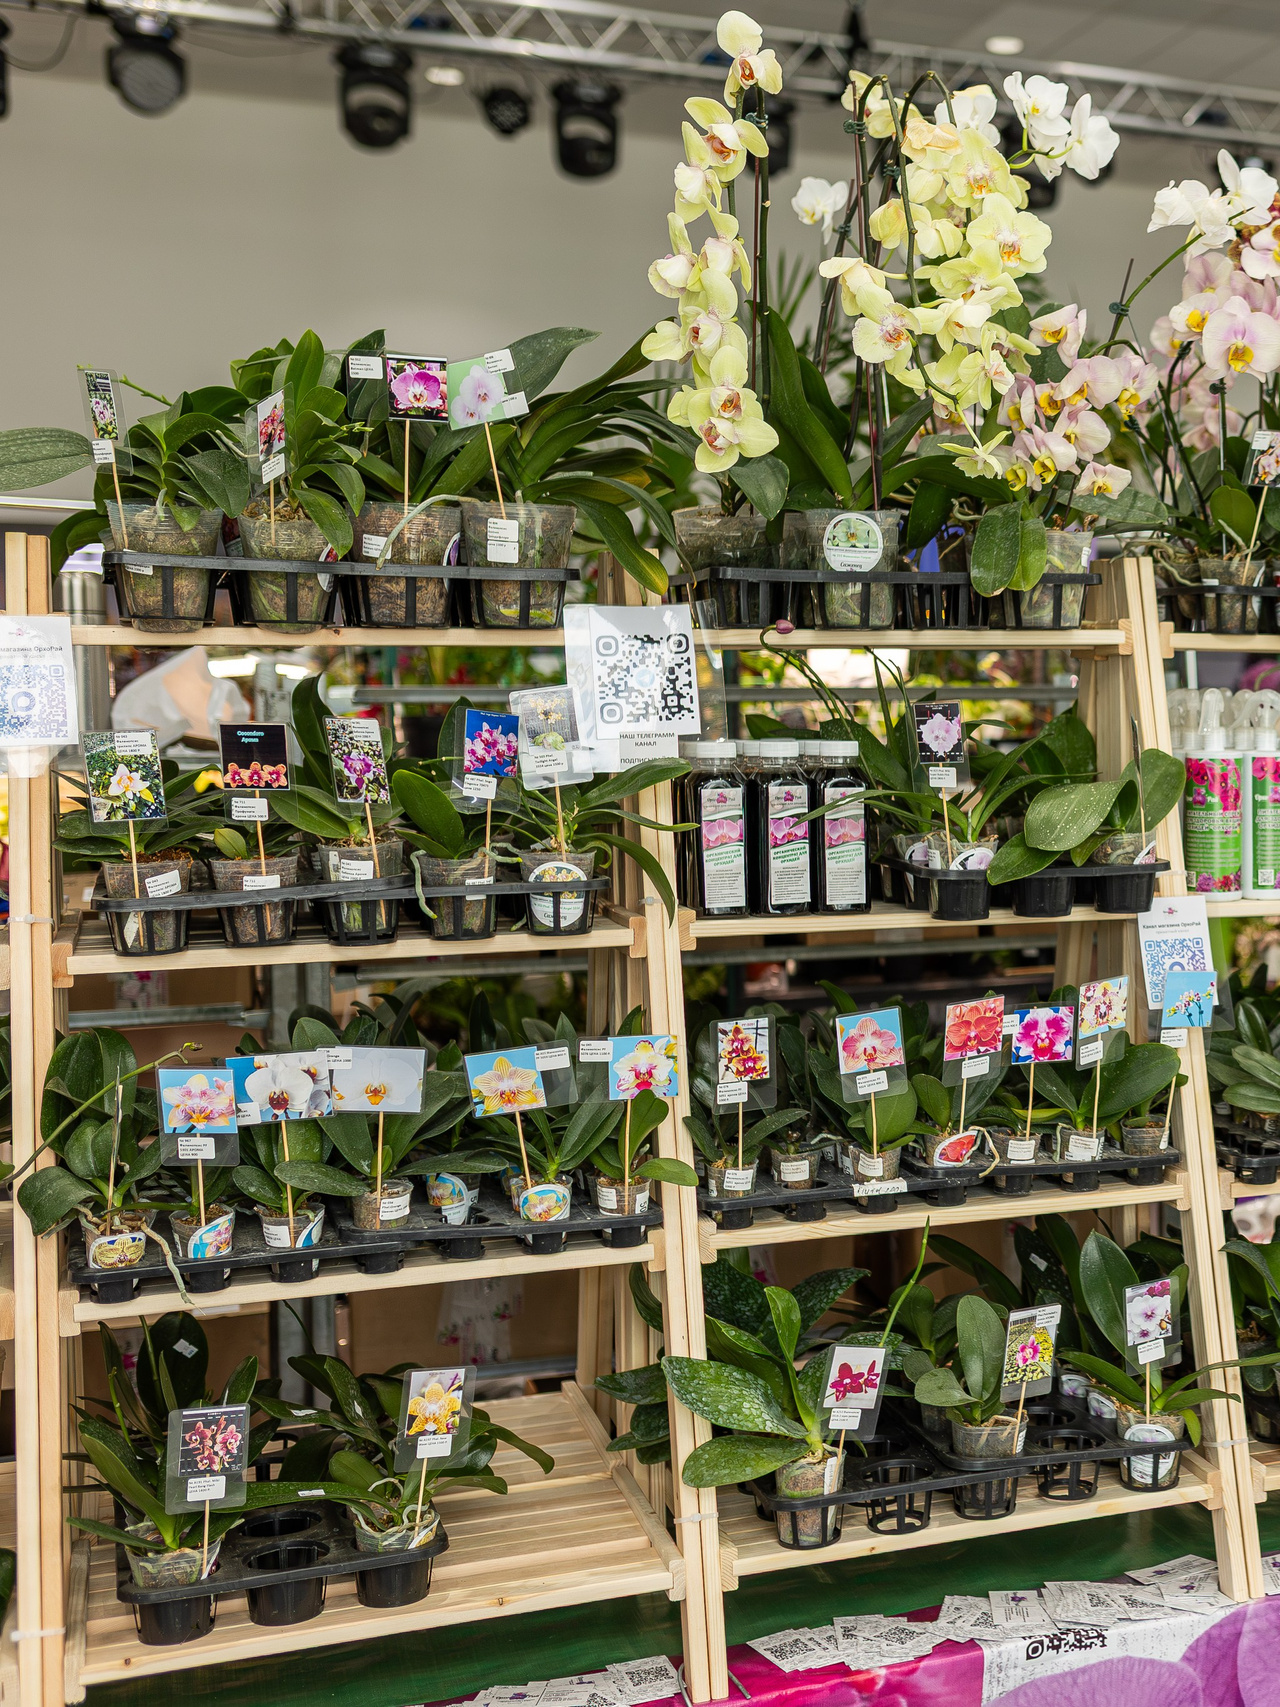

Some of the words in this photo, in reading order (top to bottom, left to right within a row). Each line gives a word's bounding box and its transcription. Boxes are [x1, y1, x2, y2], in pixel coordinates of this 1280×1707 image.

[706, 848, 741, 858] ОРГАНИЧЕСКИЙ
[773, 846, 807, 856] ОРГАНИЧЕСКИЙ
[828, 847, 862, 857] ОРГАНИЧЕСКИЙ
[705, 854, 733, 863] КОНЦЕНТРАТ
[772, 852, 799, 861] КОНЦЕНТРАТ
[780, 856, 800, 864] ОРХИДЕЙ
[835, 857, 855, 865] ОРХИДЕЙ
[713, 859, 735, 867] ОРХИДЕЙ
